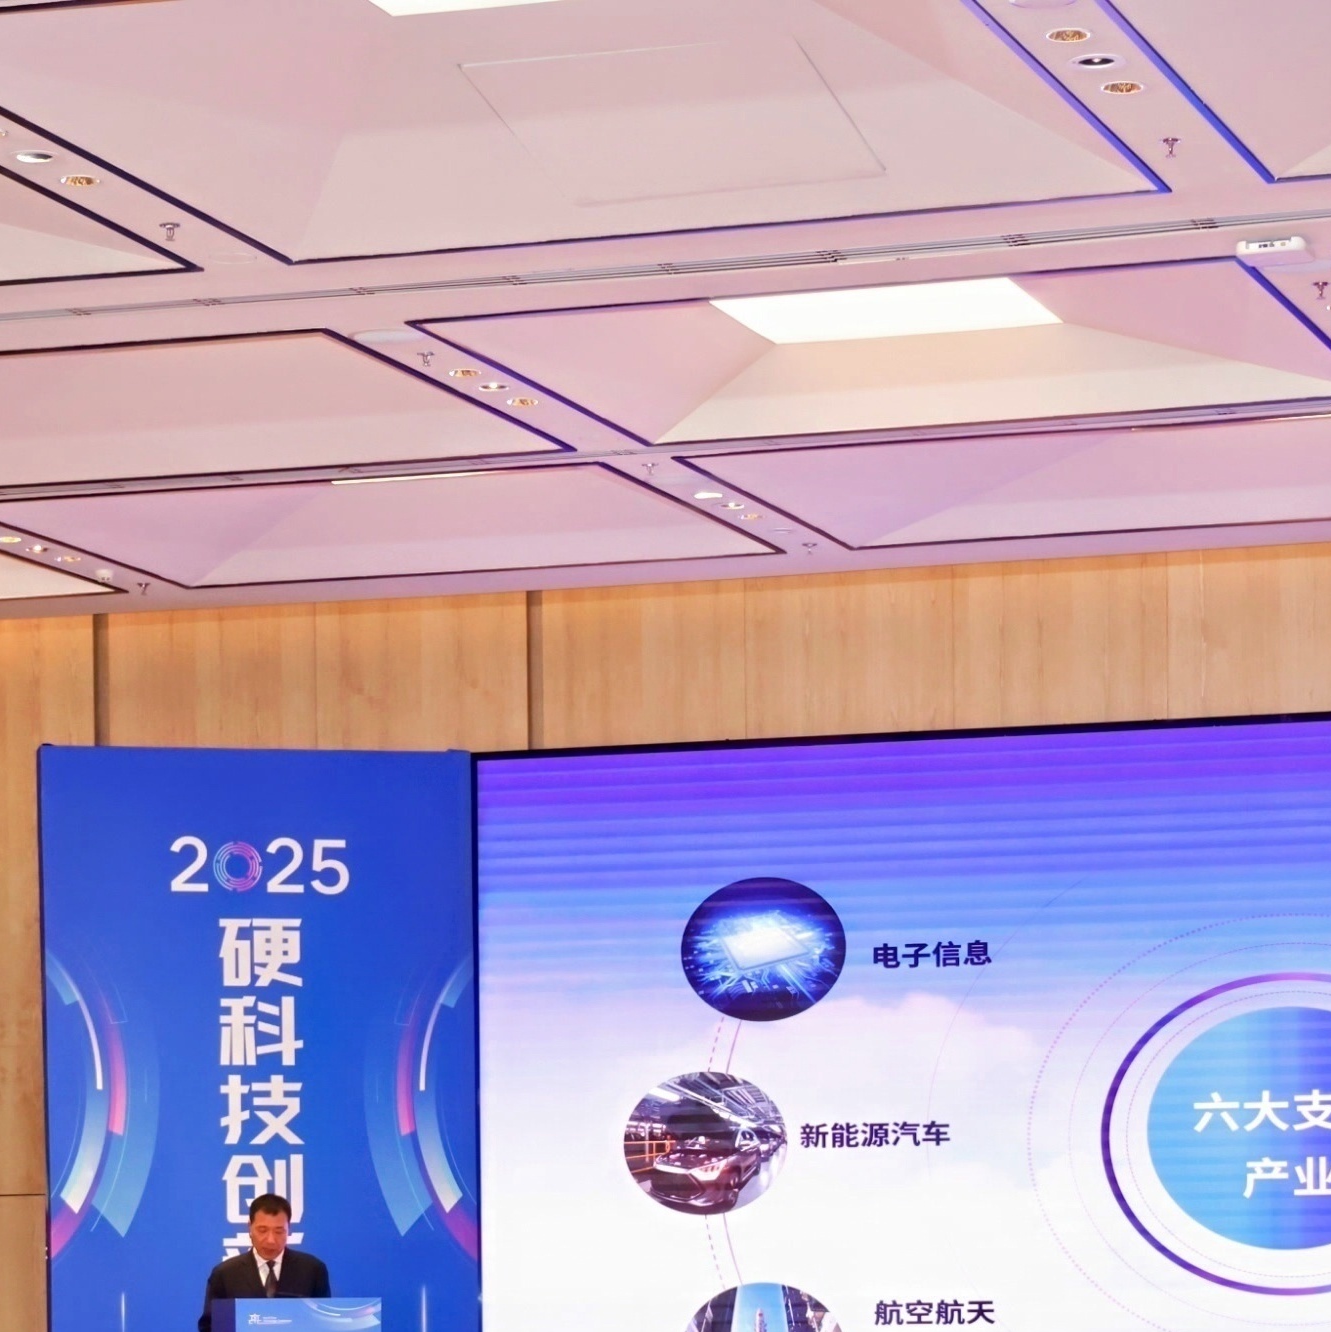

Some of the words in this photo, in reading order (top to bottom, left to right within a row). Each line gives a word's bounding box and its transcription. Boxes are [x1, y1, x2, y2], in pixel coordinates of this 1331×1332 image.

[170, 836, 350, 894] 2025
[873, 940, 992, 969] 电子信息
[800, 1120, 950, 1149] 新能源汽车
[874, 1299, 995, 1326] 航空航天
